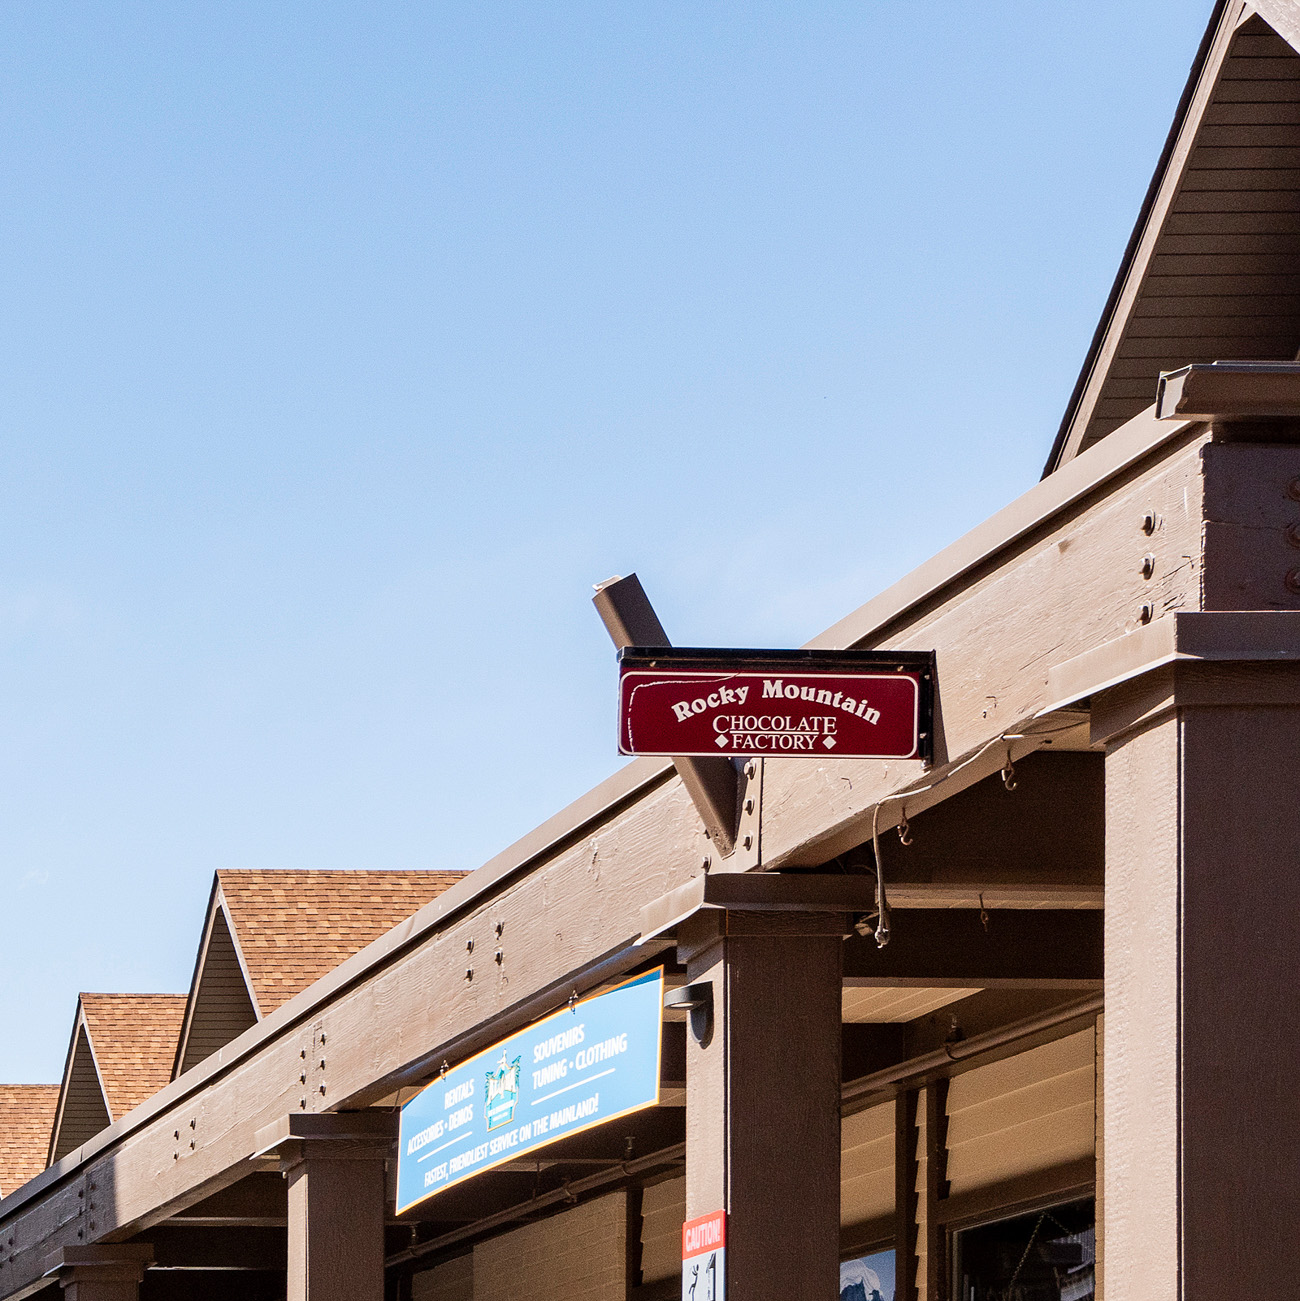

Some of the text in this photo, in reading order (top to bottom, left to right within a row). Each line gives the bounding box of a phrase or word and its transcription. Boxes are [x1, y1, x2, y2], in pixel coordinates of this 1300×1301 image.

[671, 680, 881, 726] Rocky Mountain
[712, 715, 838, 735] CHOCOLATE
[732, 734, 819, 750] FACTORY
[532, 1033, 627, 1090] TUNING CLOTHING
[533, 1024, 585, 1063] SOUVENIRS
[444, 1078, 475, 1110] RENTALS
[407, 1120, 444, 1156] ACCESSORIES
[448, 1103, 474, 1131] DEMOS
[424, 1162, 449, 1188] FASTEST,
[449, 1142, 489, 1175] FRIENDLIEST
[489, 1129, 519, 1156] SERVICE
[519, 1123, 531, 1142] ON
[533, 1115, 549, 1137] THE
[549, 1092, 599, 1130] MAINLAND!
[686, 1218, 721, 1252] CAUTION!
